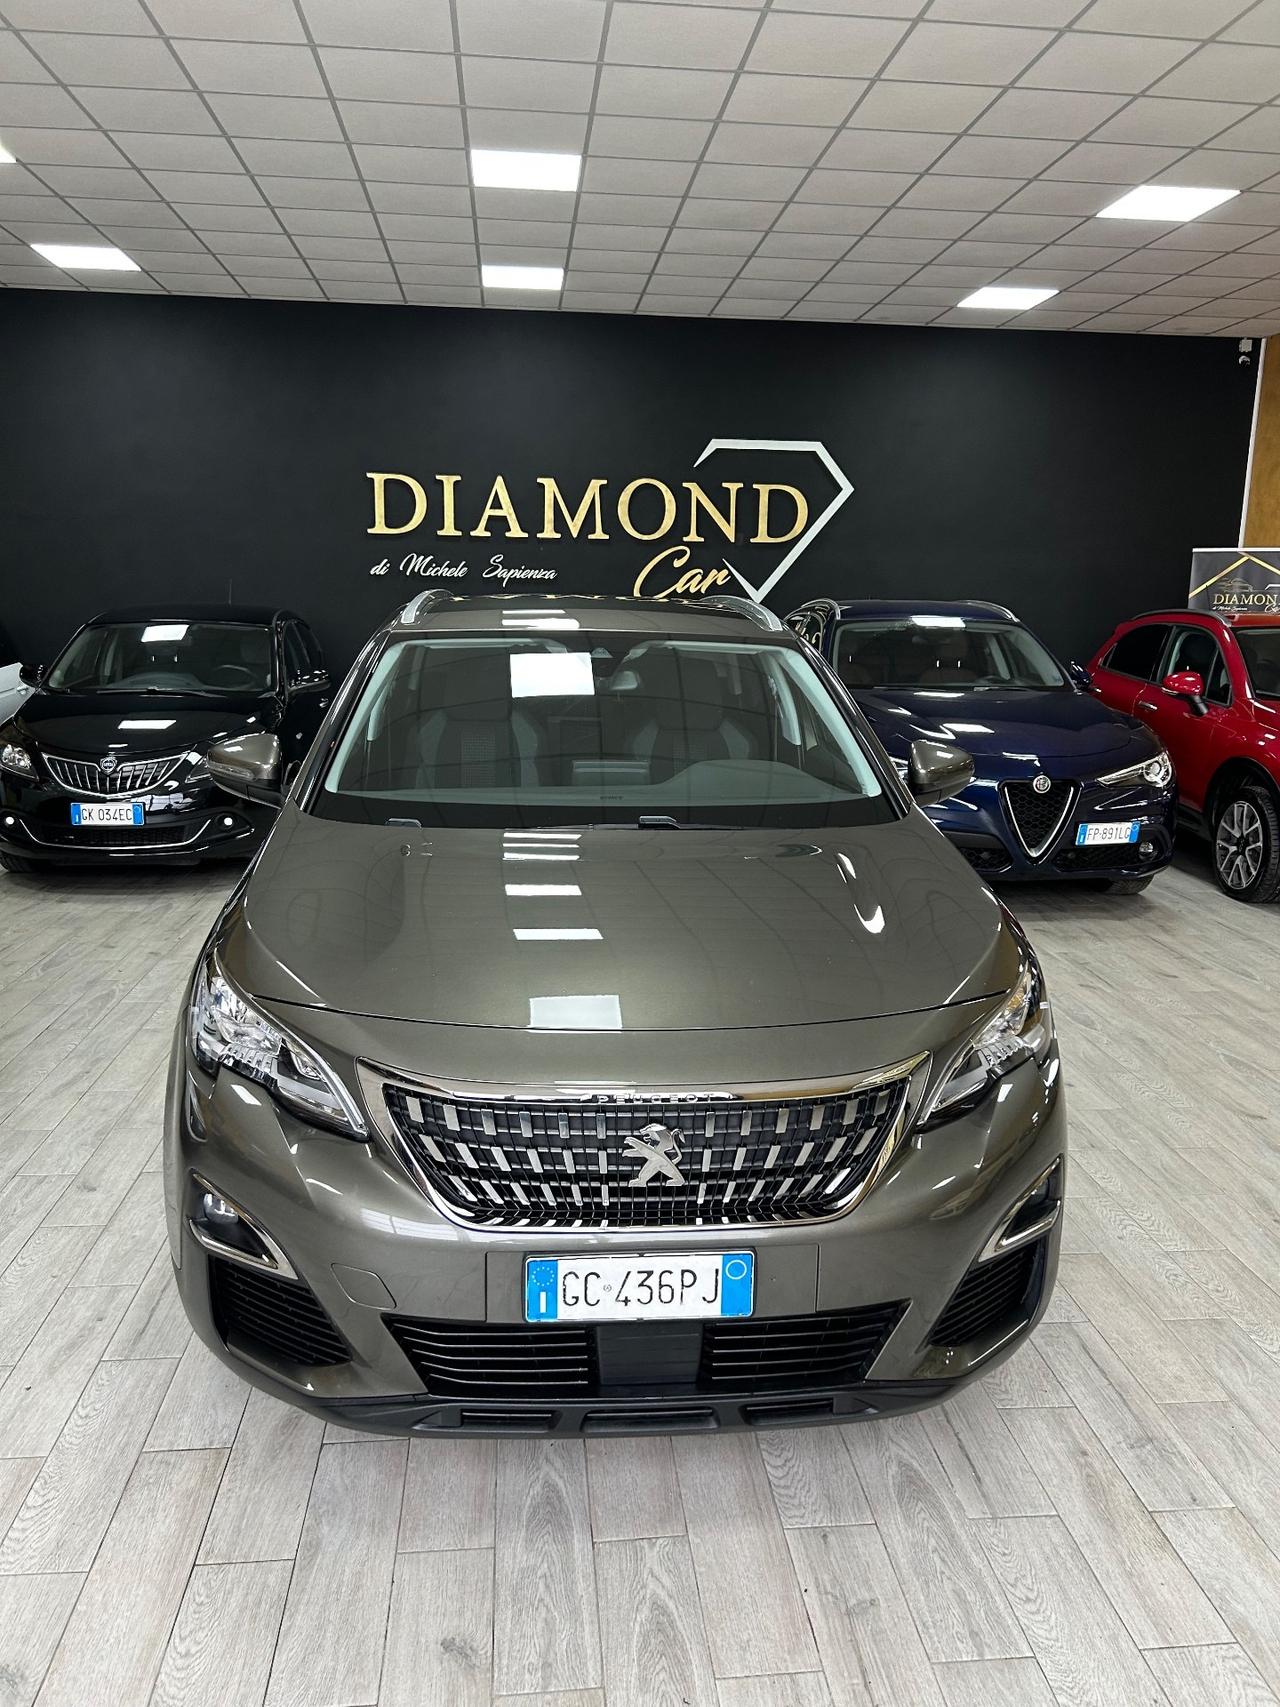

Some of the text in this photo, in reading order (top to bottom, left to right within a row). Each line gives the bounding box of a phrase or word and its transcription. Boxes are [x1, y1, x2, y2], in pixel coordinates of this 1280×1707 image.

[366, 472, 809, 543] DIAMOND
[369, 553, 558, 588] di Michele Sapienza
[633, 545, 732, 598] Car
[1212, 593, 1280, 606] DIAMON
[81, 808, 95, 821] GK
[98, 808, 132, 821] 034EC
[562, 1270, 601, 1307] GC
[615, 1268, 720, 1307] 436PJ
